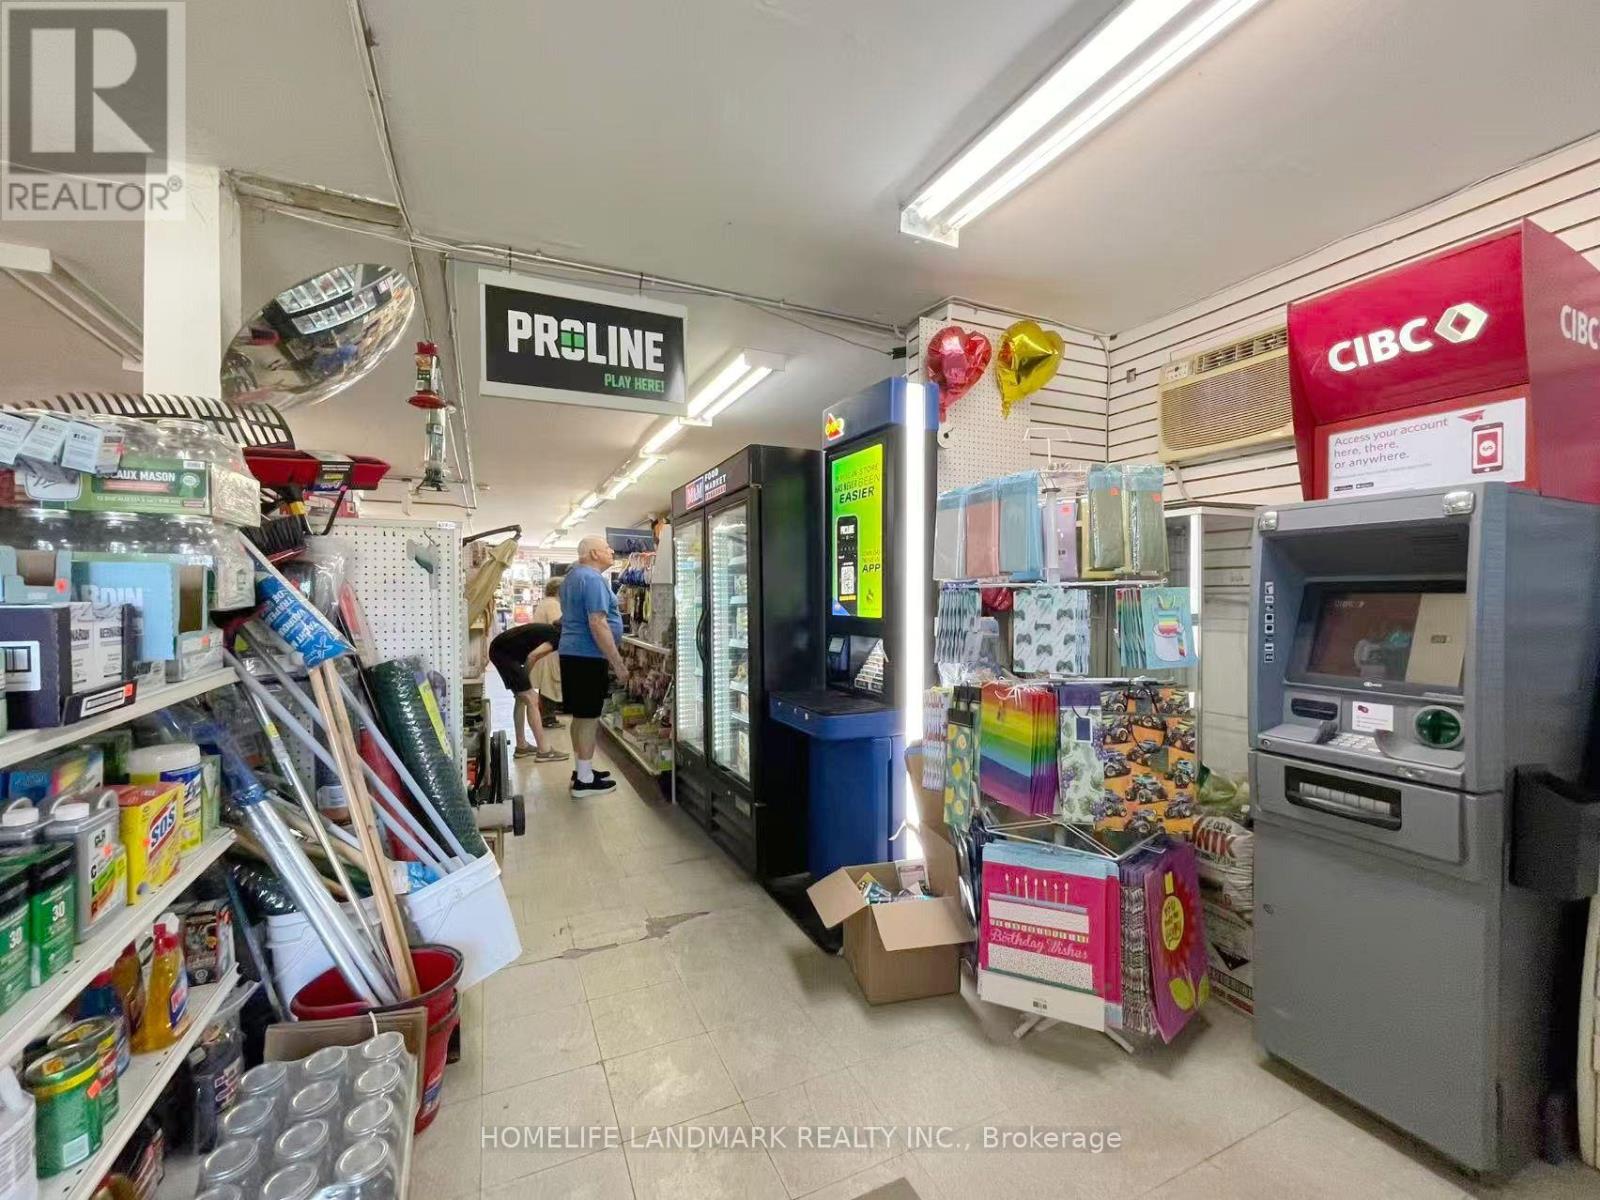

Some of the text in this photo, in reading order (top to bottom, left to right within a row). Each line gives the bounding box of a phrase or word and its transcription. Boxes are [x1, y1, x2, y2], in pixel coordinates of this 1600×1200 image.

[1560, 304, 1600, 350] CIBC
[508, 310, 664, 372] PROLINE
[1328, 317, 1433, 372] CIBC
[604, 373, 665, 393] PLAY HERE!
[1334, 418, 1449, 447] Access your account
[1334, 450, 1410, 470] or anywhere.
[141, 471, 176, 482] MASON
[704, 467, 719, 482] FOOD
[839, 486, 875, 504] EASIER
[862, 563, 881, 573] APP
[52, 900, 65, 921] 30
[9, 926, 23, 949] 30
[990, 928, 1089, 960] Birthday Wishes
